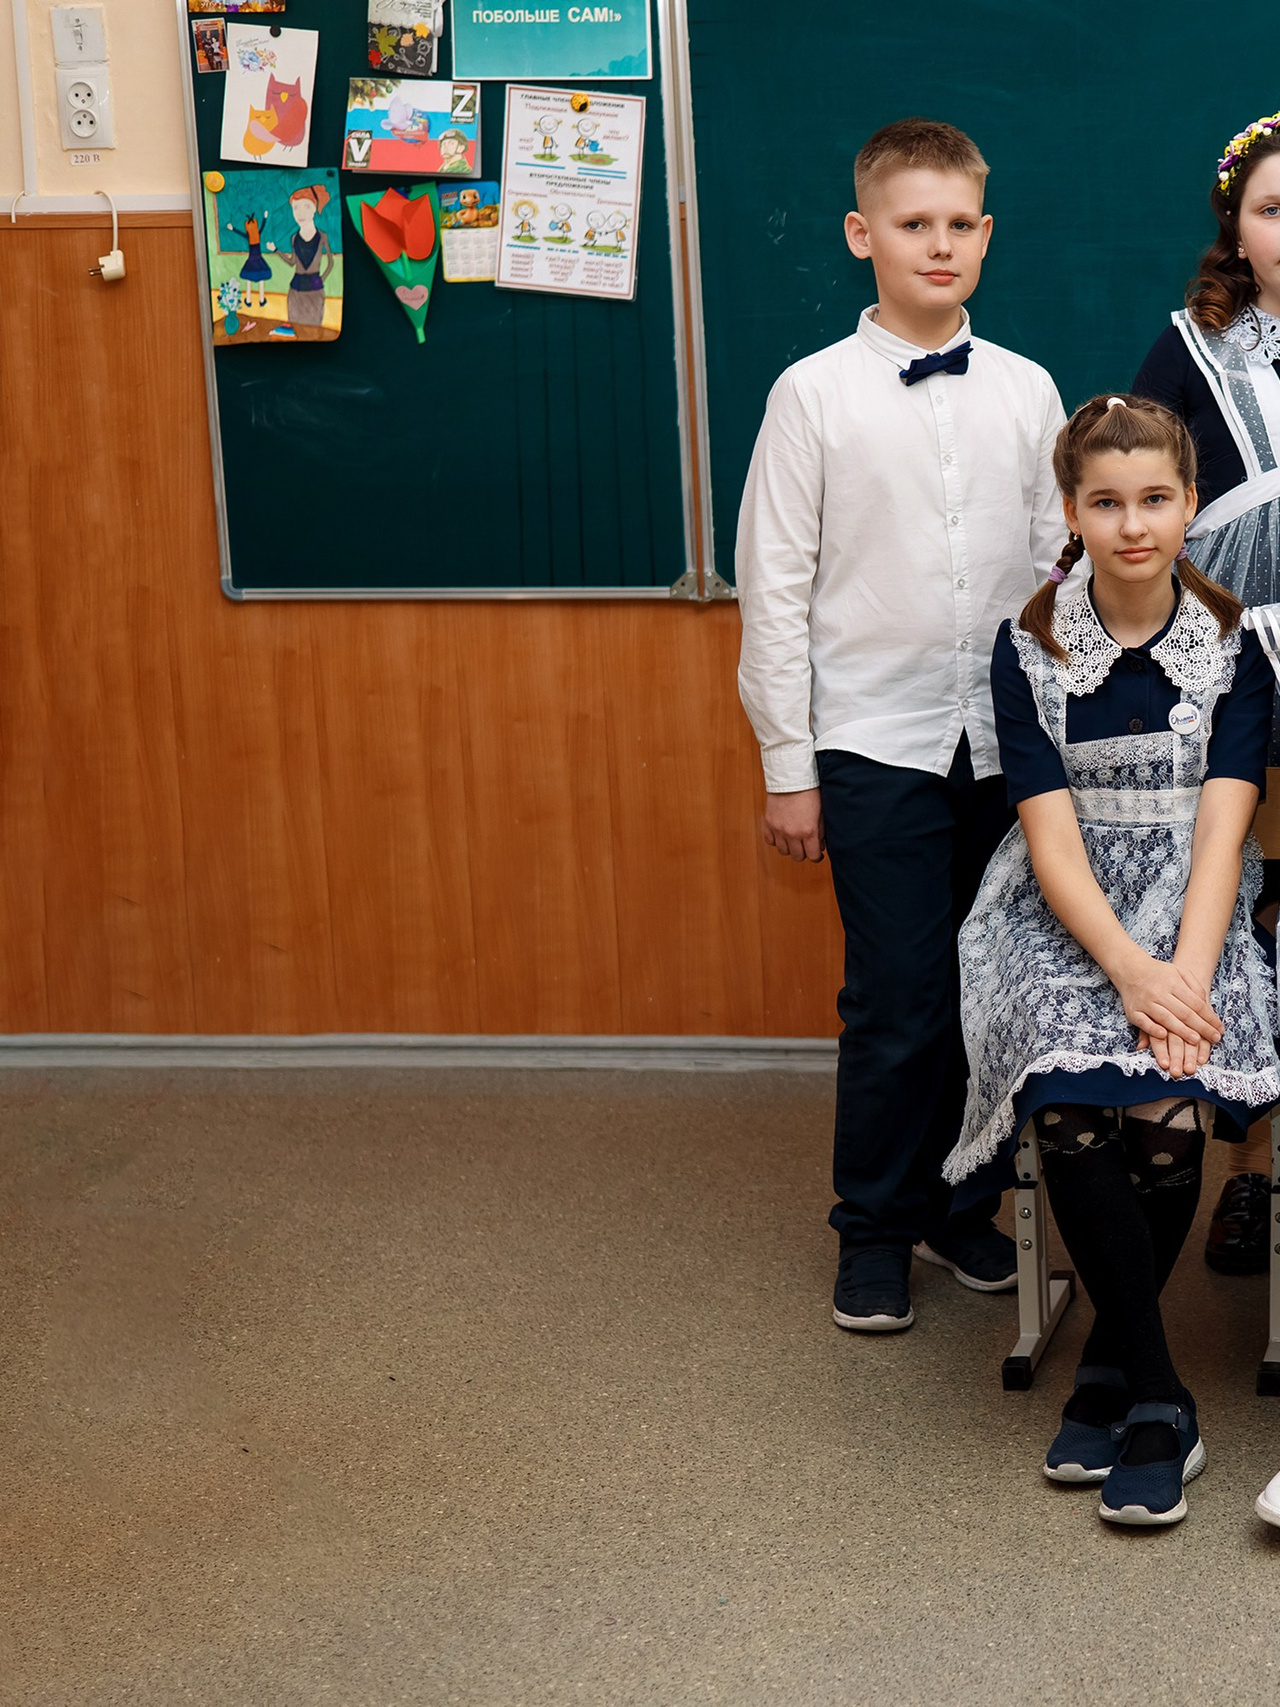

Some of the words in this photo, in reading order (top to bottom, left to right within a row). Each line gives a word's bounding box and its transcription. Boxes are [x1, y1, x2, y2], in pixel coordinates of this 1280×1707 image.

[473, 9, 560, 23] ПОБОЛЬШЕ
[567, 7, 622, 22] САМ!»
[452, 89, 474, 117] Z
[74, 154, 90, 163] 220
[349, 139, 372, 161] V
